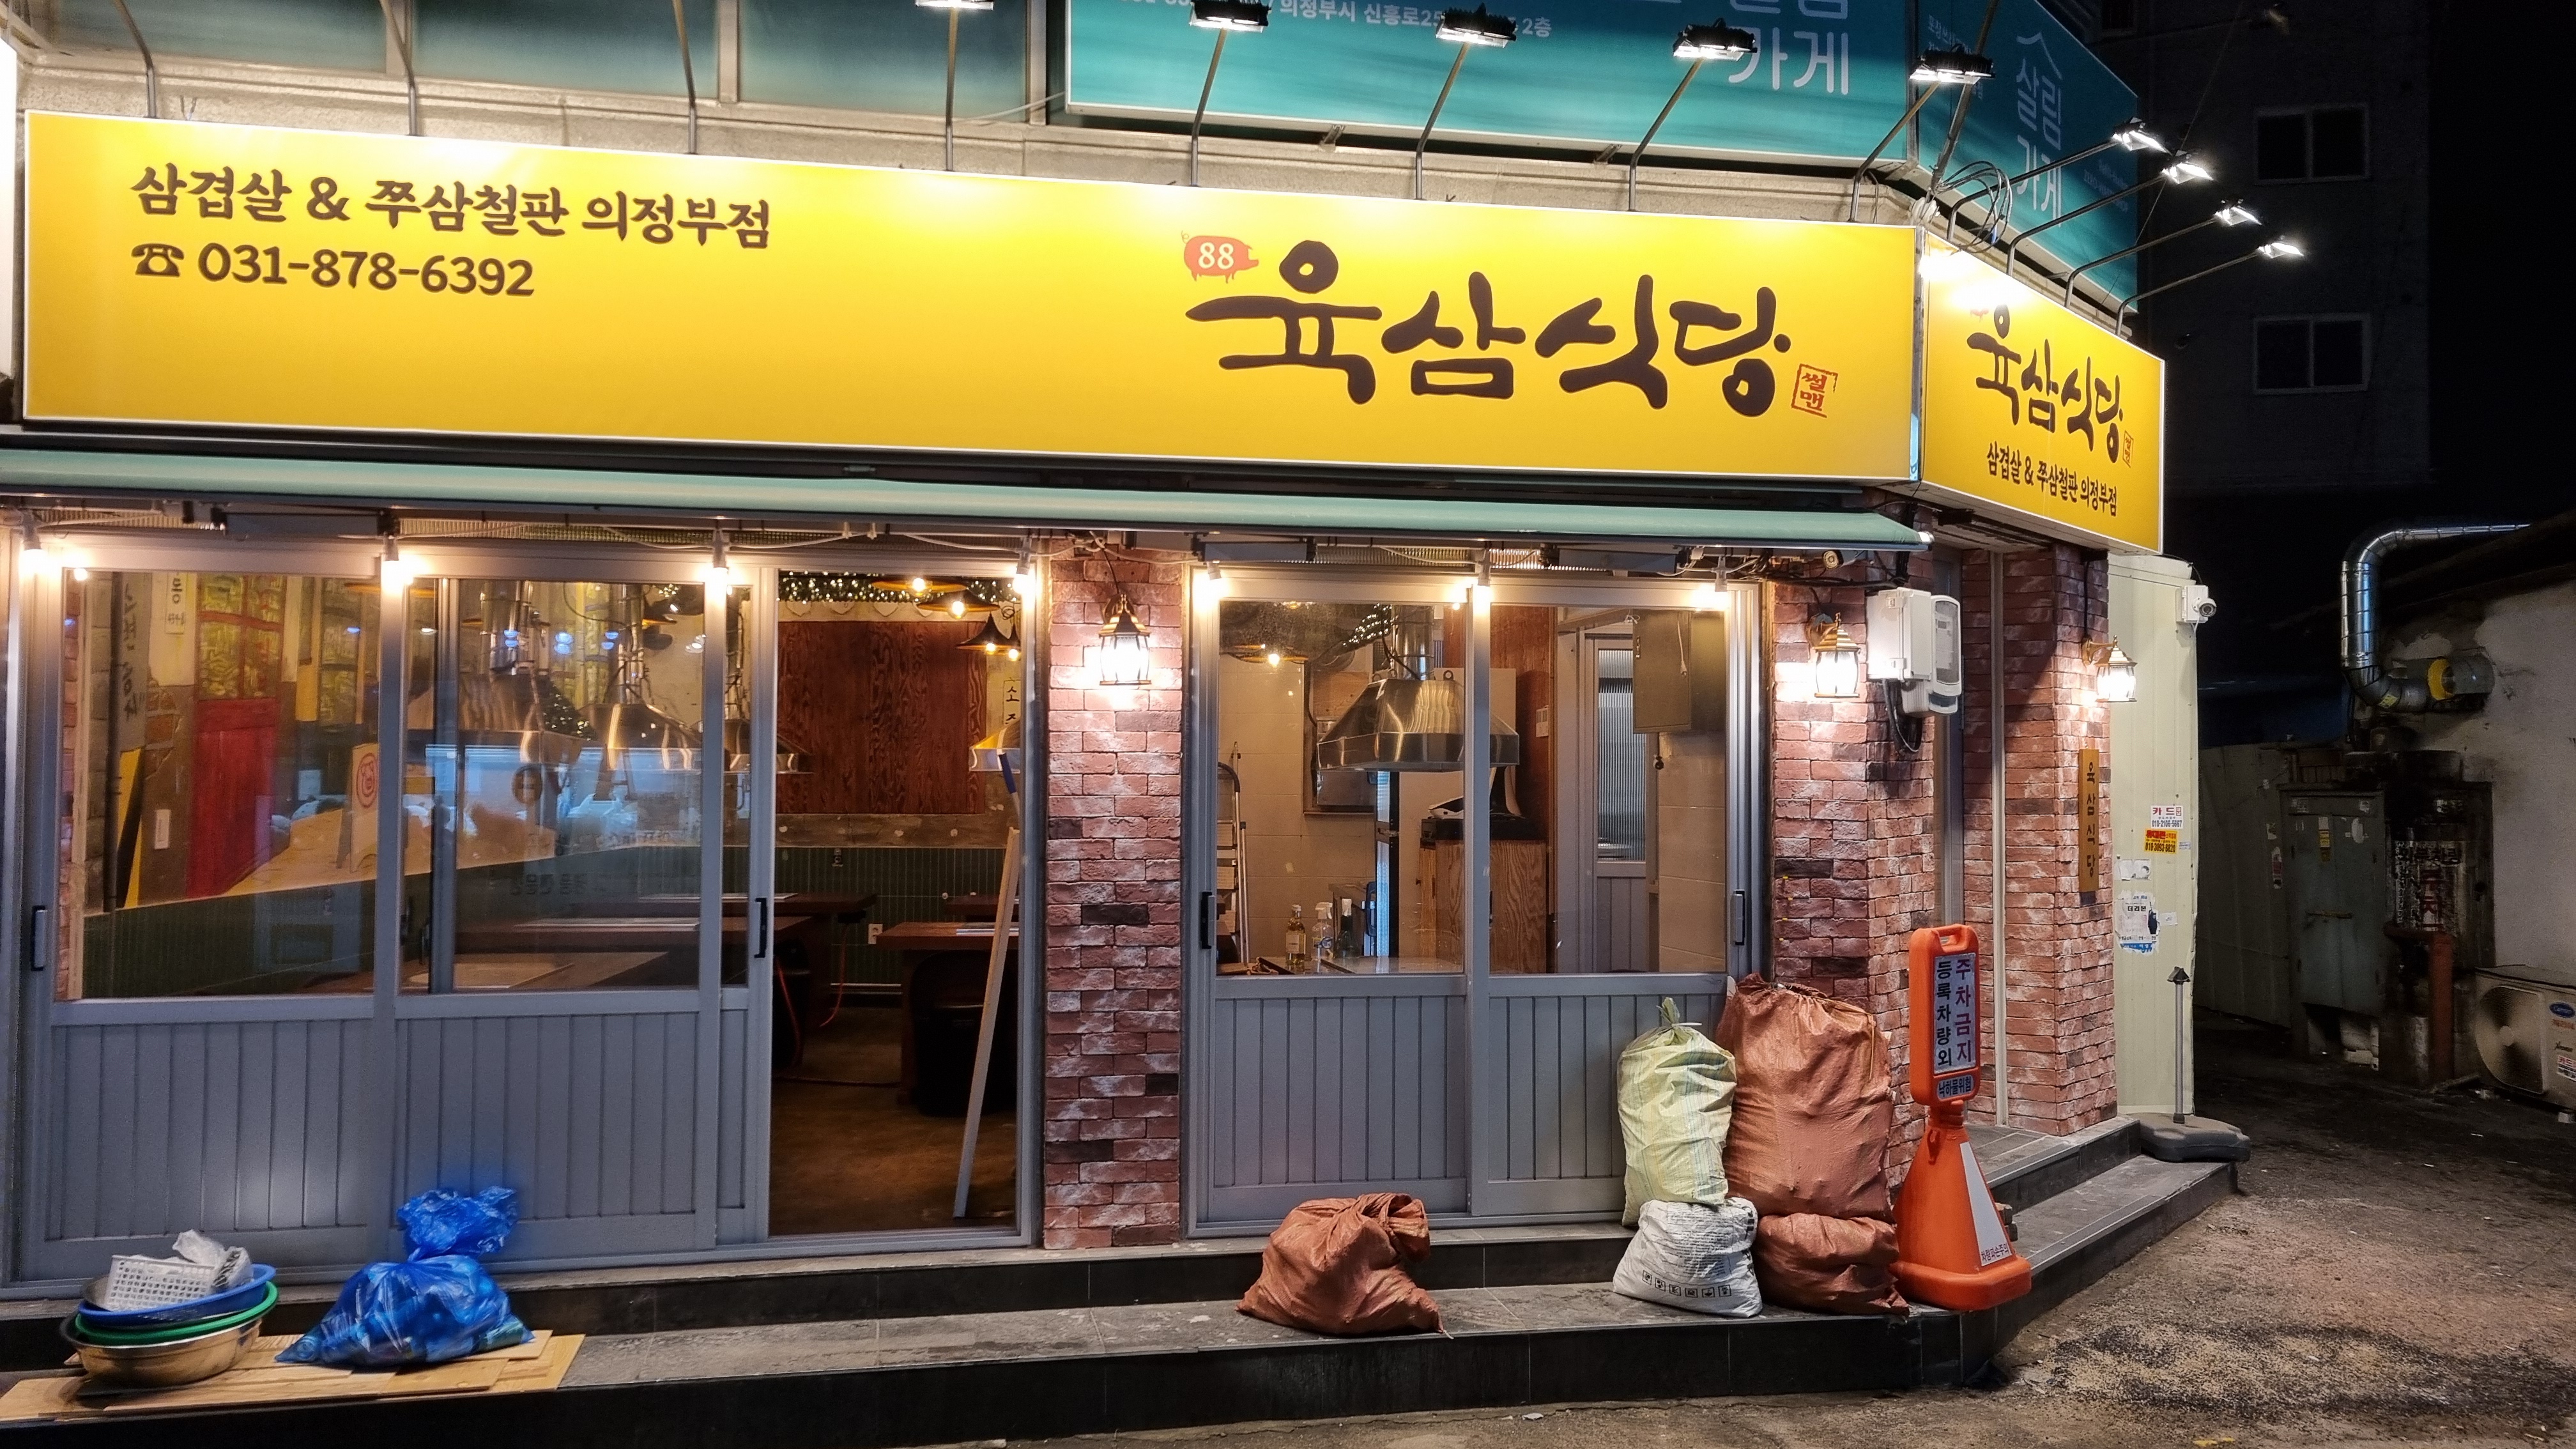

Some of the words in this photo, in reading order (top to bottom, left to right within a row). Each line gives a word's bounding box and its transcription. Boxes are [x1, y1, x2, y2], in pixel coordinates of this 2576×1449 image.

[1280, 0, 1356, 22] 의정부시
[1522, 17, 1552, 38] 2층
[1729, 26, 1849, 95] 가게
[132, 162, 292, 222] 삼겹살
[307, 176, 351, 220] &
[365, 179, 569, 236] 쭈삼철판
[581, 190, 769, 249] 의정부점
[197, 242, 535, 297] 031-878-6392
[1198, 242, 1235, 270] 88
[1184, 240, 1792, 417] 육삼식당
[1966, 303, 2124, 464] 육삼식당
[1986, 441, 2021, 485] 삼겹살
[2024, 456, 2034, 486] &
[2037, 460, 2078, 503] 쭈삼철판
[2080, 475, 2117, 517] 의정부점
[2087, 762, 2096, 878] 육삼식당
[1936, 960, 1952, 1066] 등록차량외
[1955, 958, 1972, 1063] 주차금지
[1938, 1076, 1972, 1098] 낙하물위험
